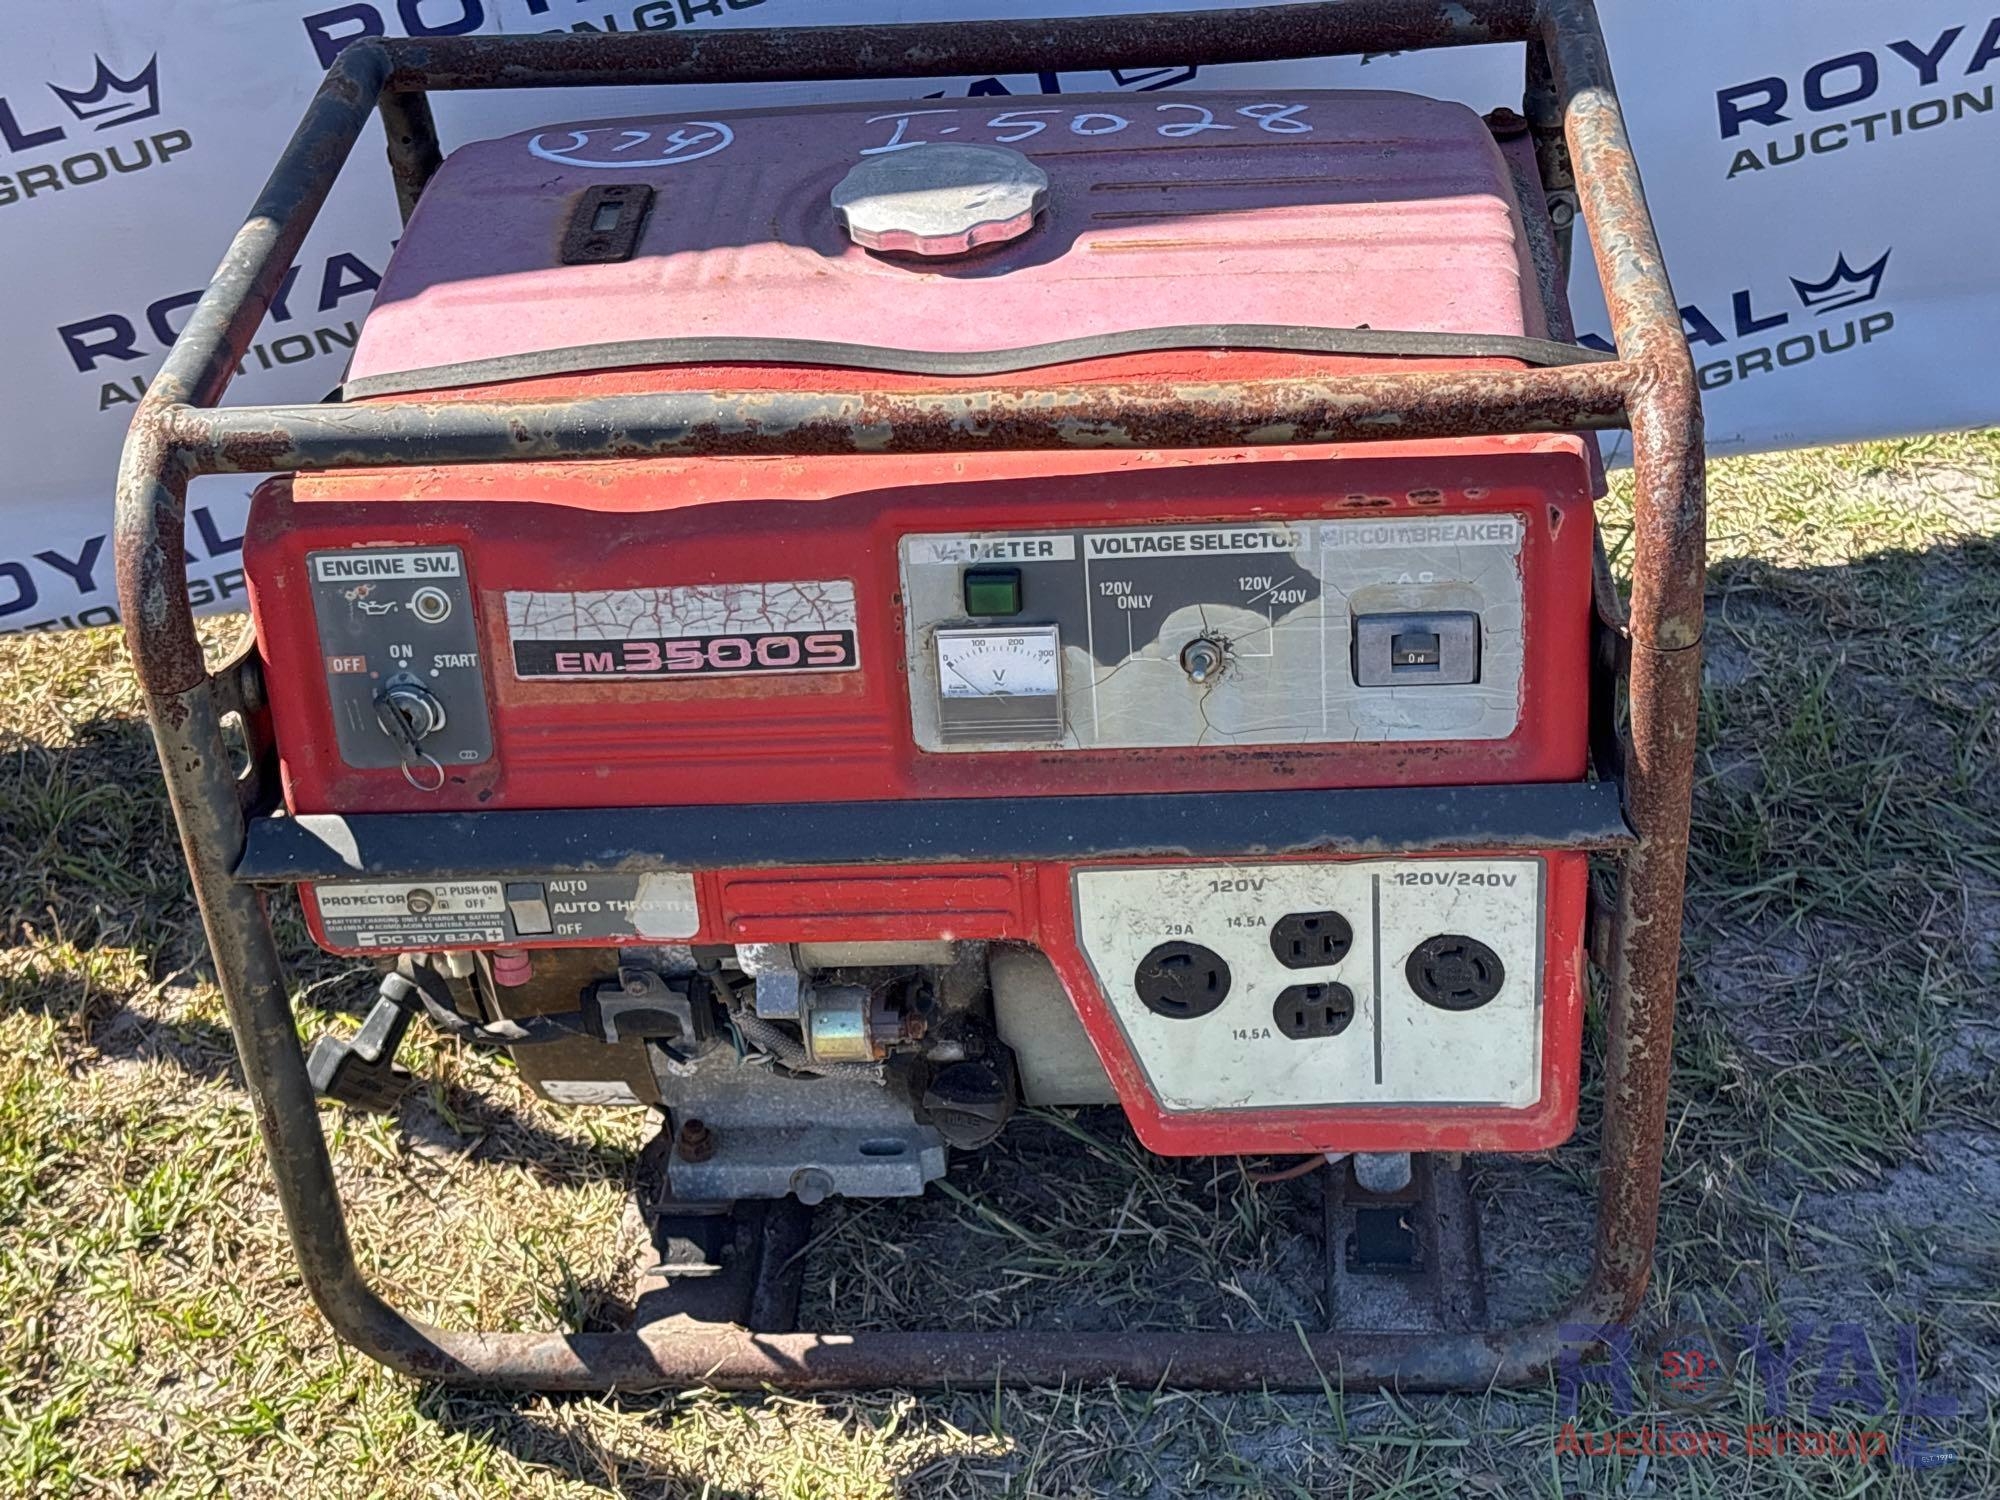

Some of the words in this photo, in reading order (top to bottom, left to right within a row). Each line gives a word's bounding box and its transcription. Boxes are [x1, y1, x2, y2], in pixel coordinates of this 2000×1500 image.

[1725, 85, 1993, 180] AUCTION
[1698, 311, 1895, 391] GROUP
[1413, 523, 1514, 543] BREAKER
[1090, 536, 1186, 555] VOLTAGE
[1190, 530, 1302, 551] SELECTOR
[322, 558, 405, 577] ENGINE
[414, 556, 456, 573] SW.
[1238, 576, 1273, 591] 120V
[1398, 571, 1434, 583] AC
[1099, 580, 1133, 596] 120V
[1117, 595, 1153, 610] ONLY
[1270, 590, 1307, 605] 240V
[389, 645, 413, 658] ON
[942, 654, 949, 662] 0
[333, 658, 360, 672] OFF
[434, 653, 477, 668] START
[993, 669, 1006, 682] V
[550, 880, 588, 892] AUTO
[1207, 878, 1265, 894] 120V
[1393, 871, 1518, 888] 120V/240V
[321, 894, 405, 906] PROTECTOR
[464, 899, 486, 909] OFF
[554, 901, 600, 914] AUTO
[557, 923, 583, 935] OFF
[1226, 916, 1267, 929] 14.5A
[1165, 924, 1194, 937] 29A
[378, 935, 404, 945] DC
[408, 934, 440, 944] 12V
[445, 933, 484, 943] 8.3A
[1232, 1029, 1272, 1042] 14.5A
